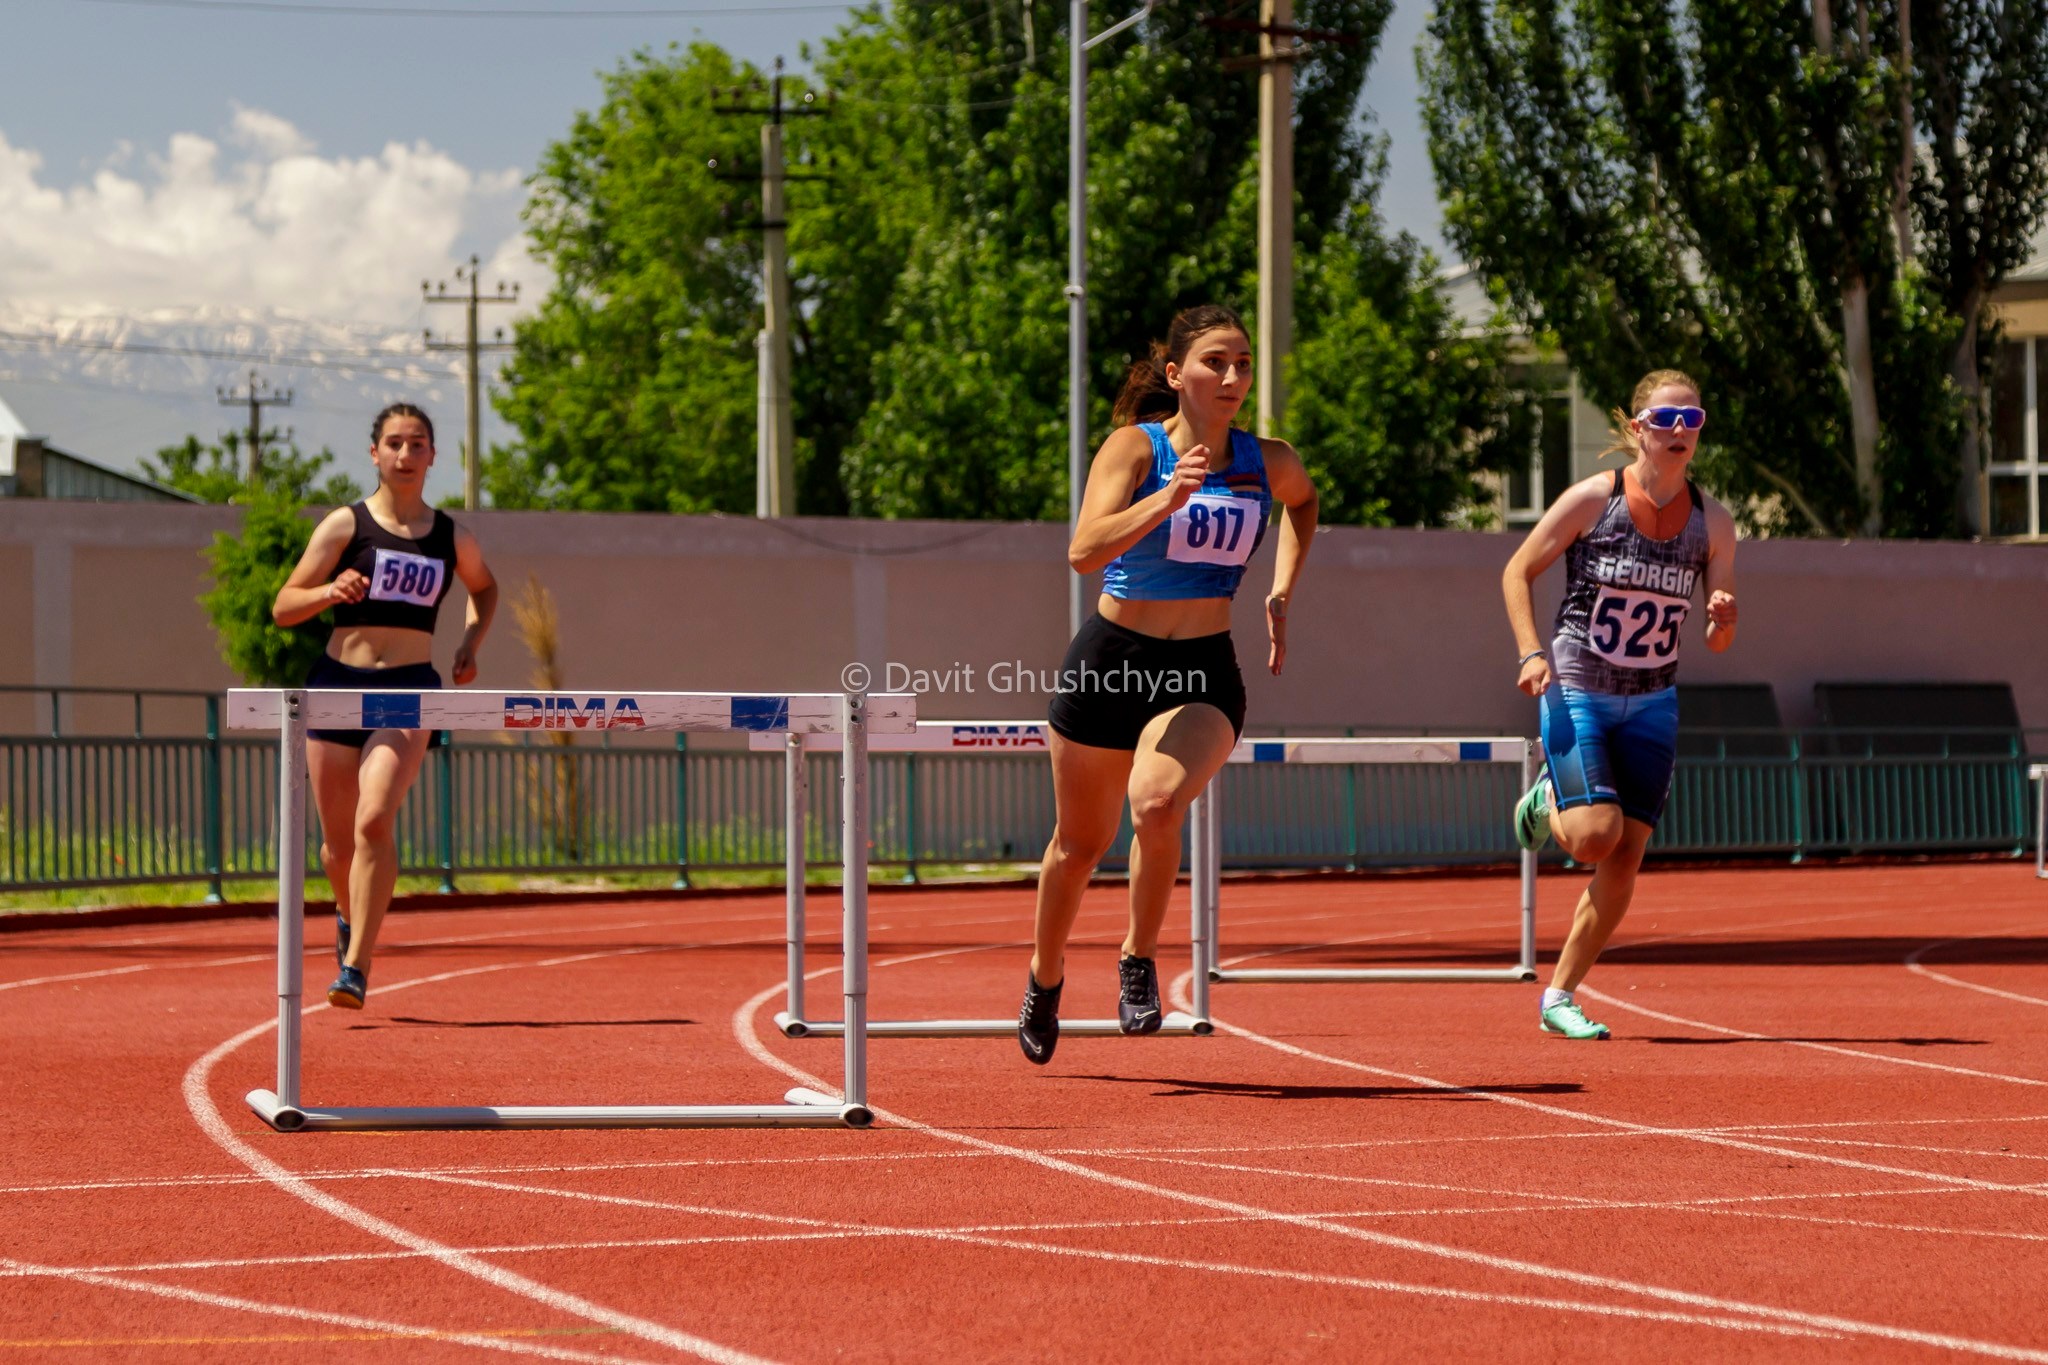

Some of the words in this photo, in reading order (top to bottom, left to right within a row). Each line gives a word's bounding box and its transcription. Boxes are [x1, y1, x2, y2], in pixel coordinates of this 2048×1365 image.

[1187, 503, 1245, 552] 817
[382, 559, 436, 597] 580
[1598, 556, 1695, 596] GEORGIA
[1593, 597, 1684, 658] 525
[504, 697, 646, 728] DIMA
[953, 726, 1045, 746] DIMA
